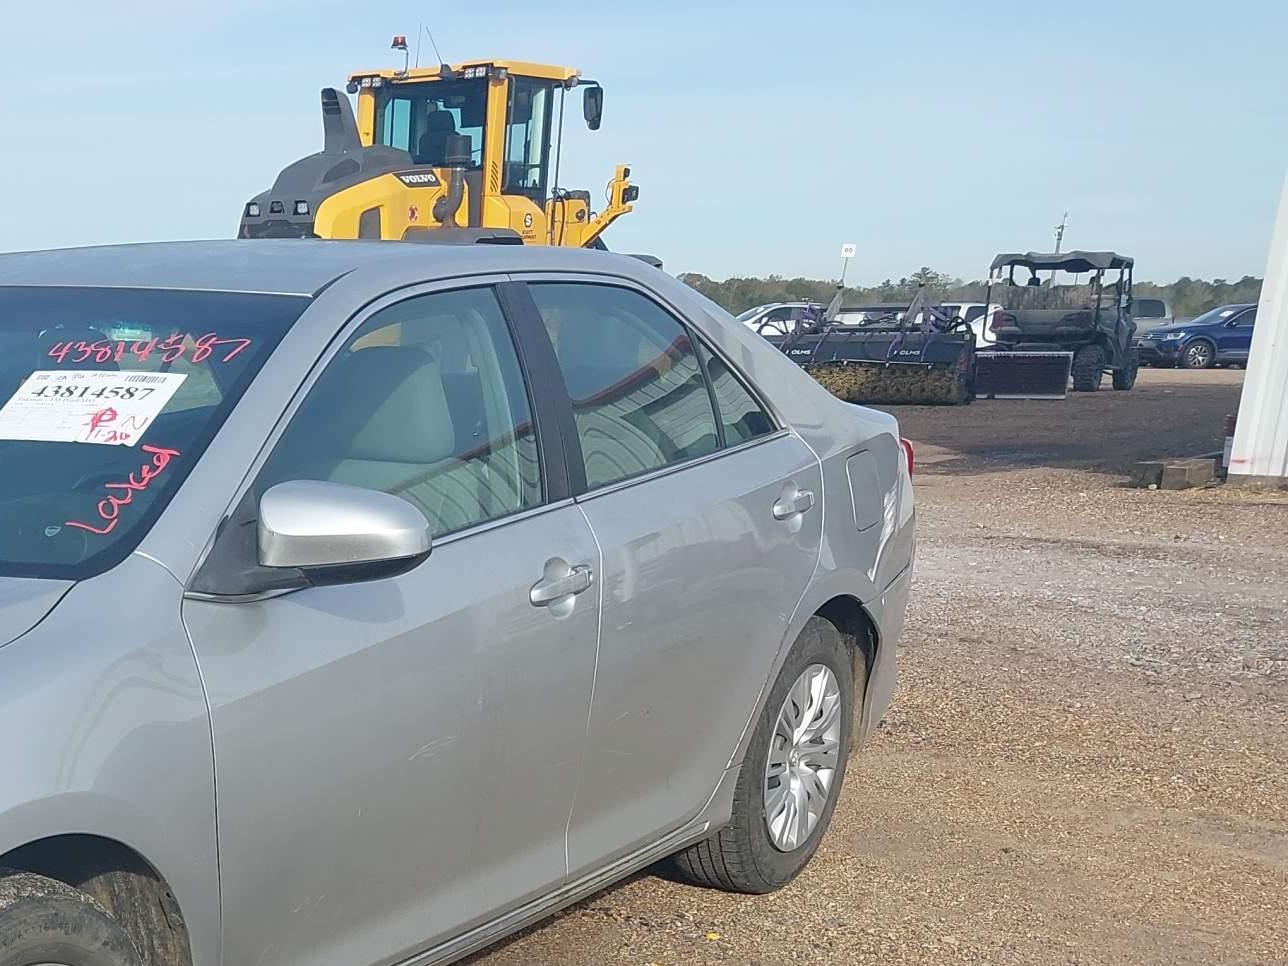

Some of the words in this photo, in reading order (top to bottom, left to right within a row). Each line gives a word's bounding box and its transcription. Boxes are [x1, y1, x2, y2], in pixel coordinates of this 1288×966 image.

[399, 173, 436, 184] VOLVO
[47, 331, 253, 364] 43814587
[31, 384, 157, 401] 43814587
